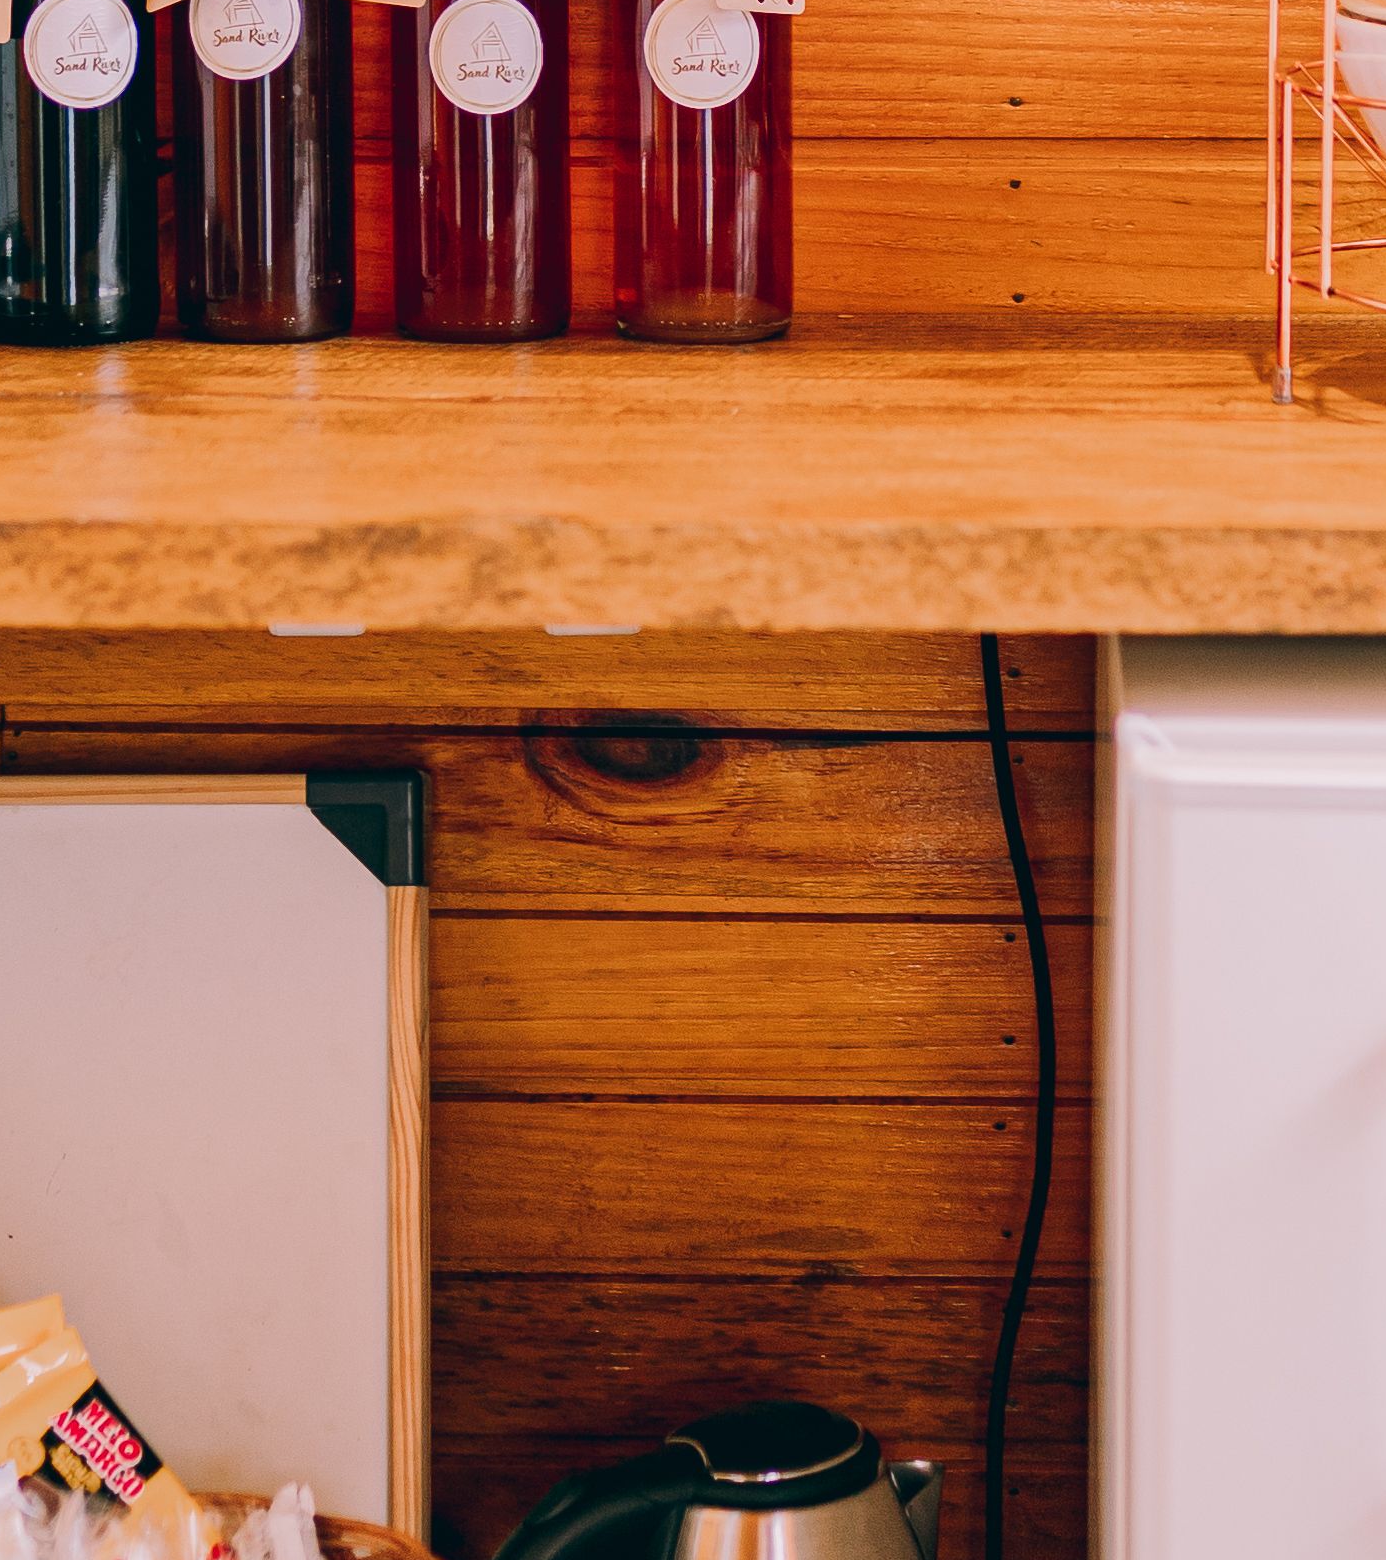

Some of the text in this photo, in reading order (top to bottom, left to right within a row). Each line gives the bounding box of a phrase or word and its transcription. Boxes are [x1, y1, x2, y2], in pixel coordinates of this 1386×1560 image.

[213, 27, 281, 47] Sand River
[54, 54, 122, 76] Sand River
[456, 63, 525, 83] Sand River
[672, 57, 740, 76] Sand River
